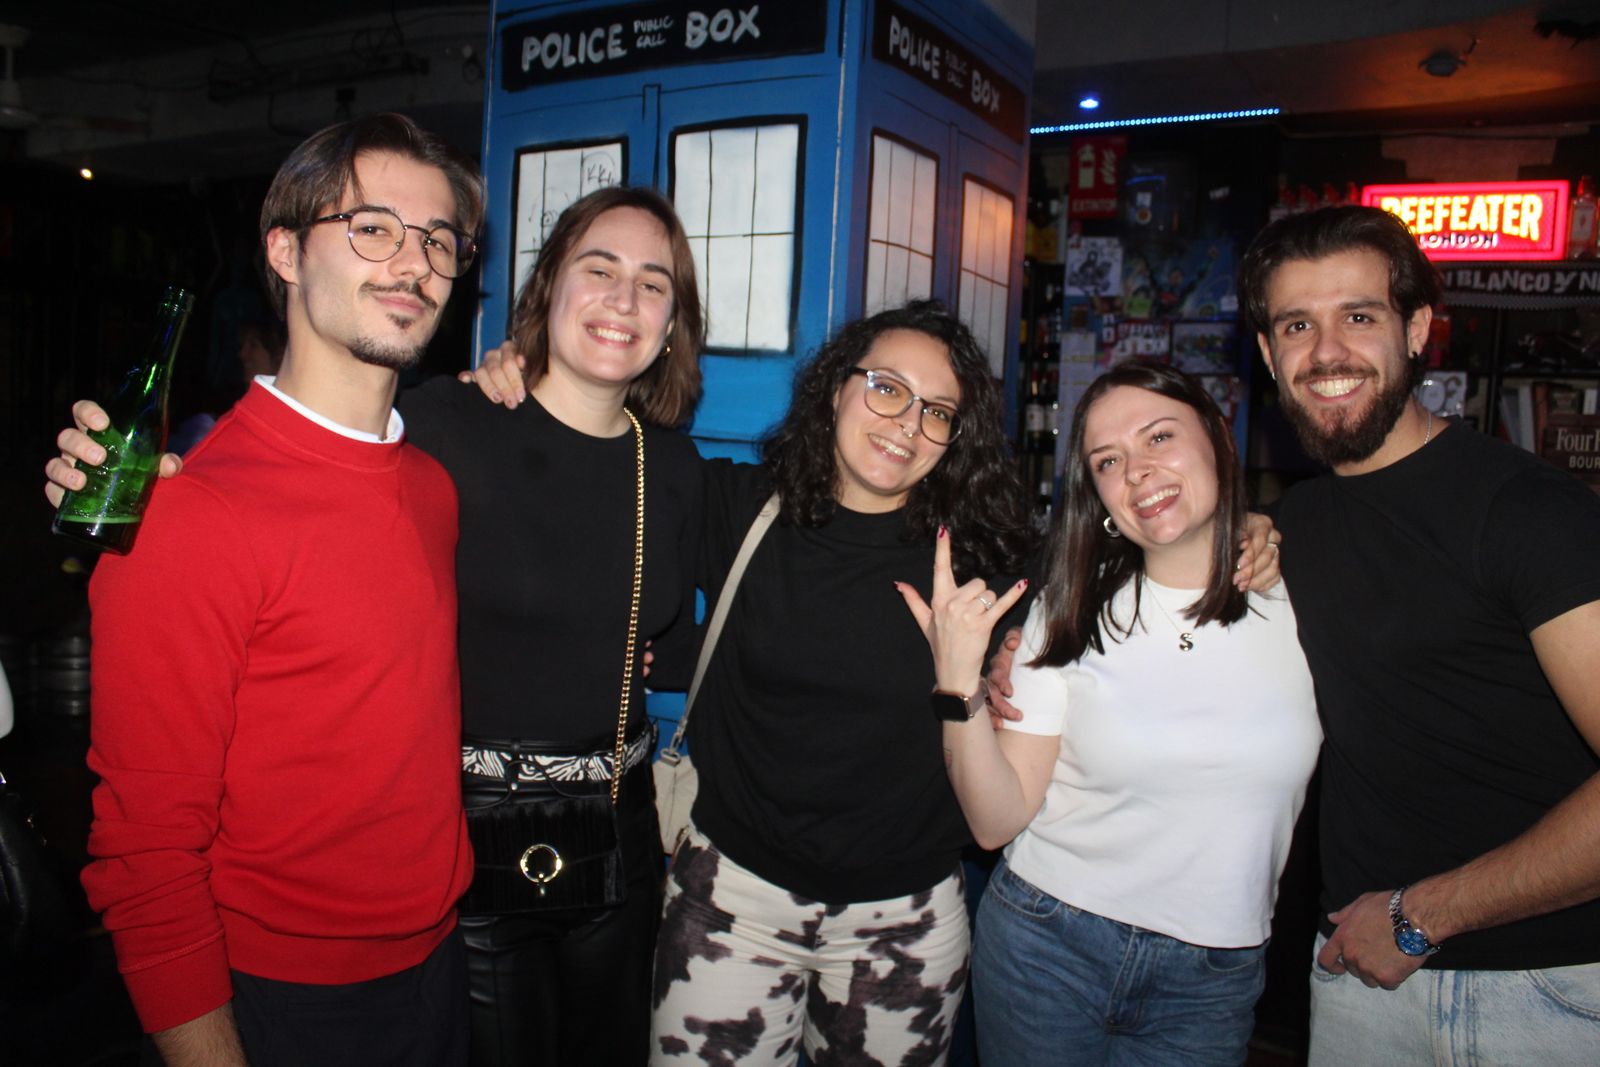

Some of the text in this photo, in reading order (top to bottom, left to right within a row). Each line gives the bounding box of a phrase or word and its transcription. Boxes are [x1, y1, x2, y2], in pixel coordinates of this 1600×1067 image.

[634, 15, 674, 31] PUBLIC
[521, 5, 761, 72] POLICE BOX
[636, 35, 666, 49] CALL
[889, 15, 1000, 113] POLICE BOX
[1419, 232, 1498, 250] LONDON
[1456, 269, 1552, 294] BLANCO
[1179, 632, 1193, 652] S
